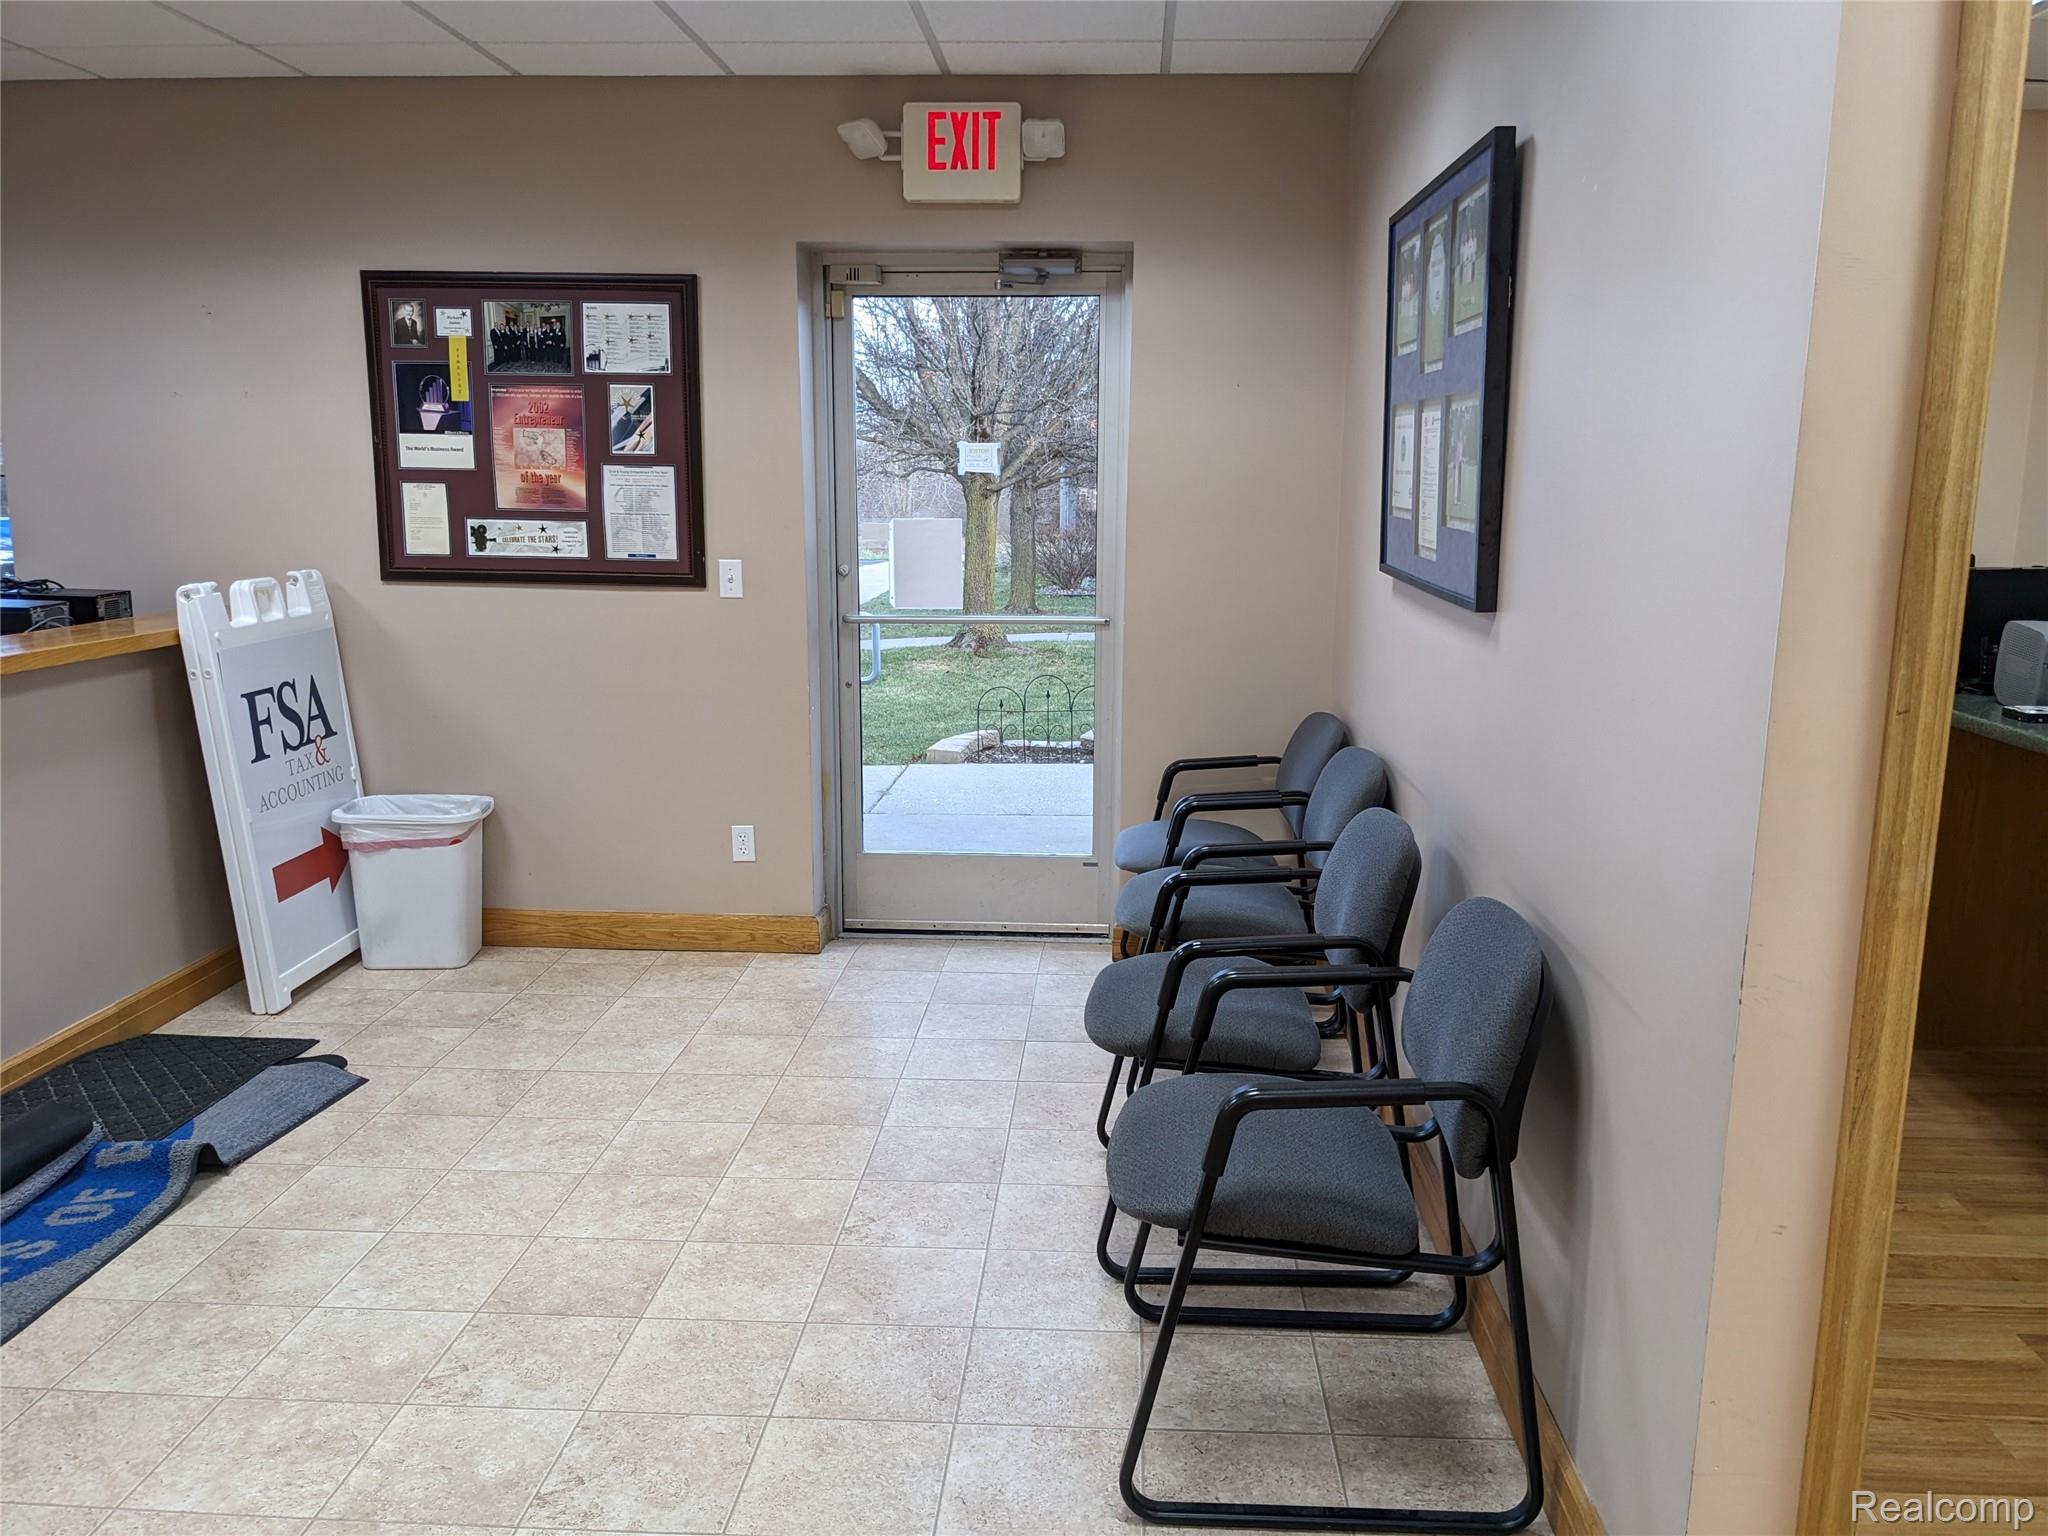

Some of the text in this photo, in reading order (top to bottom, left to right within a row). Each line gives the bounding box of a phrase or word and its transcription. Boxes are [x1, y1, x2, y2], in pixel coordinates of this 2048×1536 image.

[927, 111, 1002, 171] EXIT
[513, 413, 565, 427] Entrepreneur
[527, 400, 550, 414] 2002
[520, 471, 562, 486] of the year
[527, 535, 537, 544] THE
[240, 673, 338, 764] FSA
[285, 734, 331, 777] TAX &
[259, 765, 345, 813] ACCOUNTING
